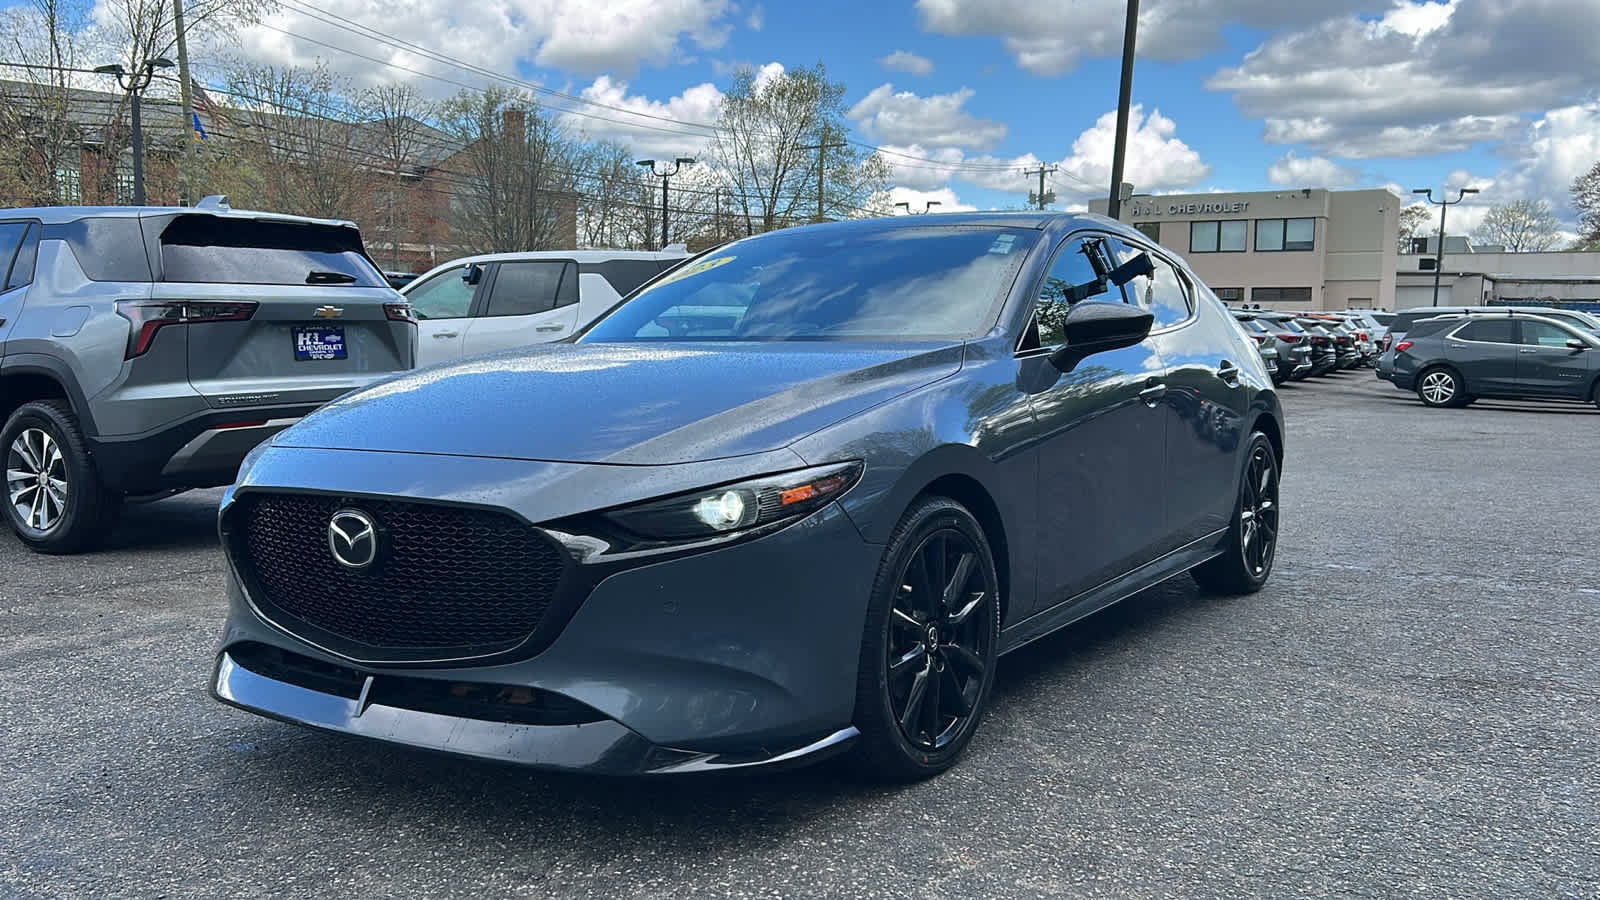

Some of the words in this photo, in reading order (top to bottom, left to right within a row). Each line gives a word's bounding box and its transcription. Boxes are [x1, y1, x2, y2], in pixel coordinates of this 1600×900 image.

[1132, 207, 1140, 217] H
[1153, 206, 1162, 216] L
[1167, 202, 1249, 216] CHEVROLET
